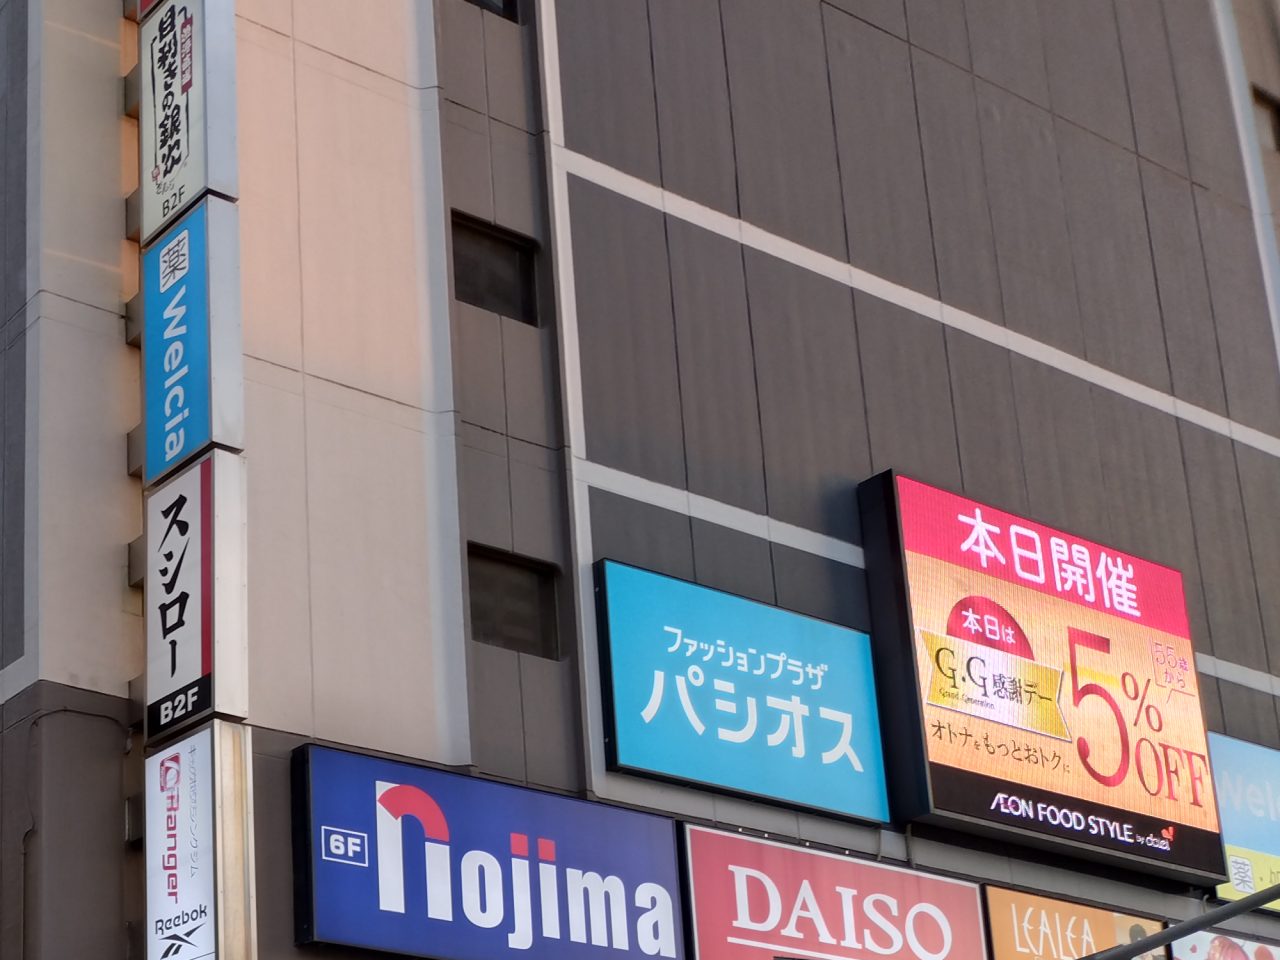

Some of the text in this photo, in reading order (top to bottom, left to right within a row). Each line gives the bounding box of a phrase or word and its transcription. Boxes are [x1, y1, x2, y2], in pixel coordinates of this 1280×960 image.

[162, 185, 186, 218] B2F
[162, 285, 190, 462] Welcia
[157, 494, 190, 678] スシロー
[957, 508, 1141, 617] 本日開催
[961, 607, 1016, 644] 本日は
[663, 626, 828, 690] ファッションプラザ
[160, 686, 199, 725] B2F
[640, 665, 864, 773] パシオス
[1135, 737, 1211, 808] OFF
[329, 834, 361, 857] 6F
[1038, 804, 1085, 831] FOOD
[1089, 815, 1135, 843] STYLE
[155, 903, 208, 936] Reebok
